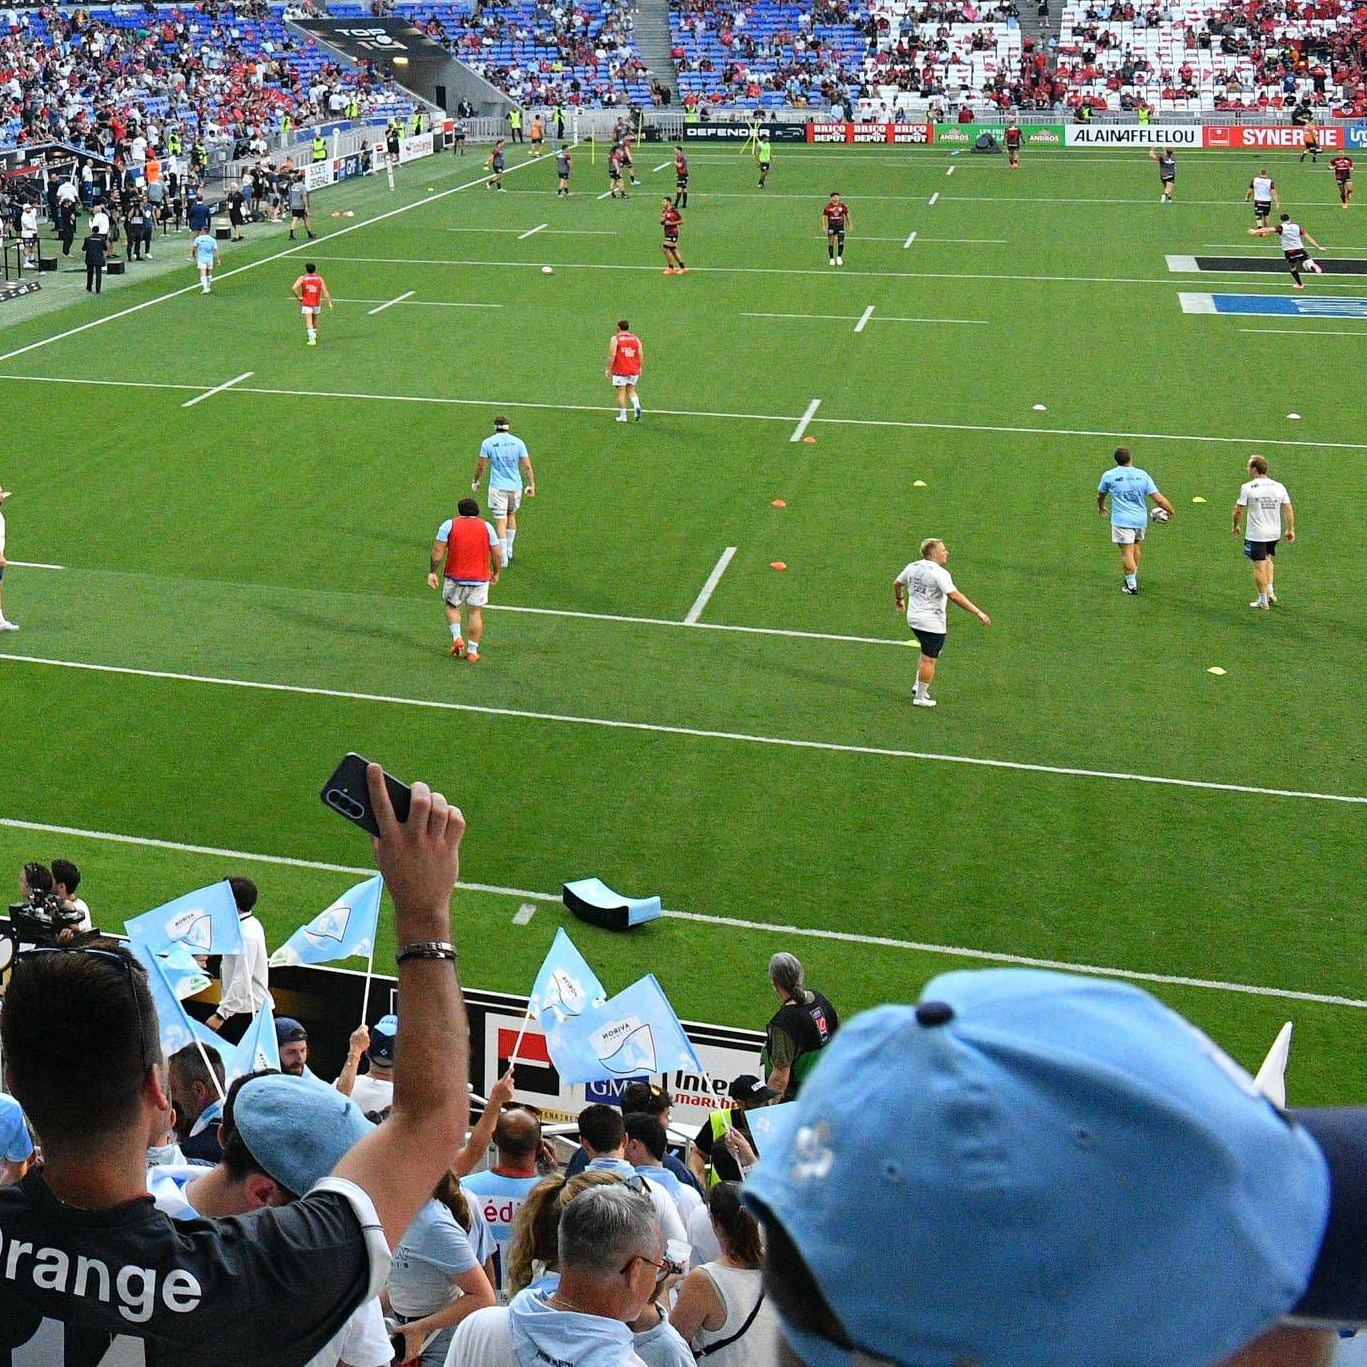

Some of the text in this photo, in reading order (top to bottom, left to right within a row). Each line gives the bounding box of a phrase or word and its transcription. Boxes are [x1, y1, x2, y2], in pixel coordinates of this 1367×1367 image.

[814, 124, 847, 133] BRICO
[854, 124, 886, 133] BRICO
[894, 124, 927, 133] BRICO
[1243, 130, 1337, 146] SYNERIE
[589, 1079, 631, 1098] GM
[675, 1070, 729, 1095] Inte
